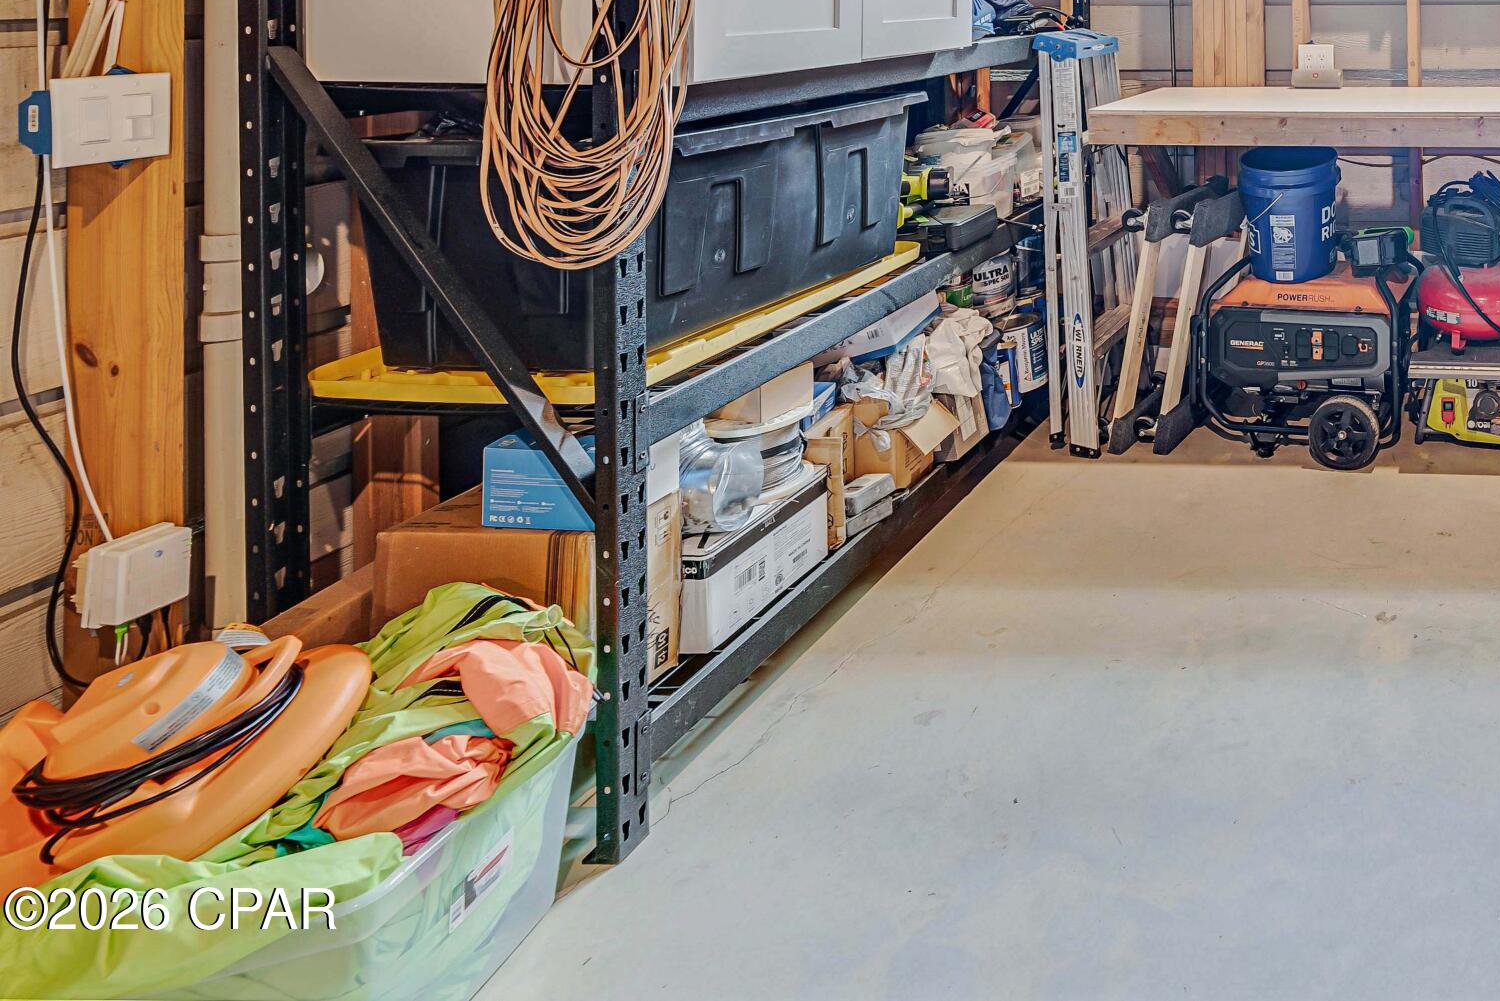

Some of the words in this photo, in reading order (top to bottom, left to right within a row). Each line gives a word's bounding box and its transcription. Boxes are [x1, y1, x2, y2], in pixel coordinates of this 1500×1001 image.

[973, 265, 1009, 282] ULTRA
[983, 277, 999, 286] SPEC
[1277, 293, 1331, 303] POWERRUSH
[1230, 339, 1264, 347] GENERAC
